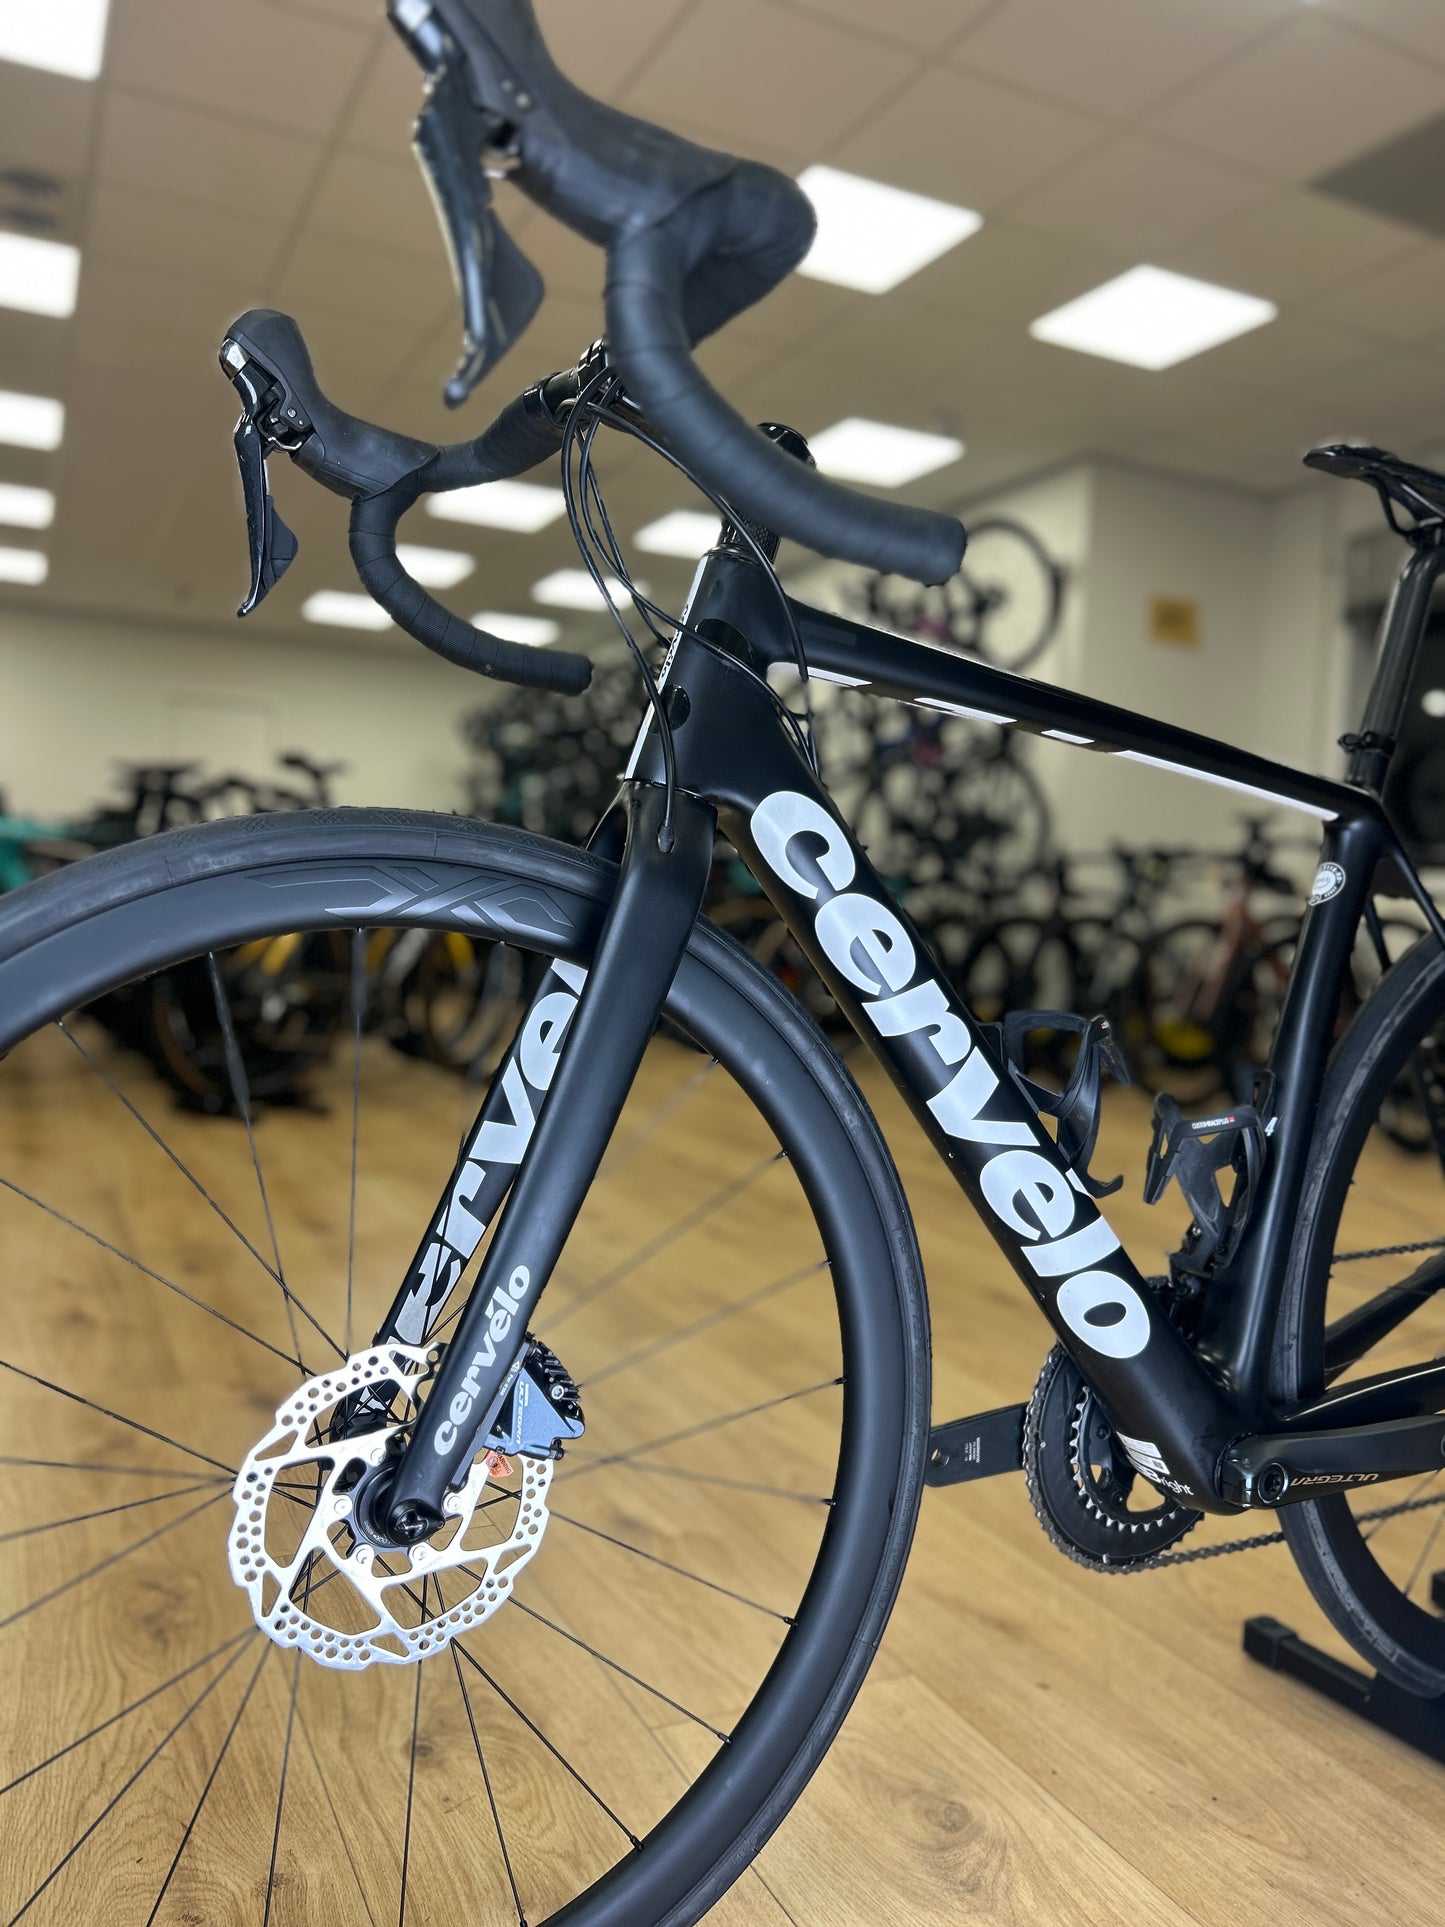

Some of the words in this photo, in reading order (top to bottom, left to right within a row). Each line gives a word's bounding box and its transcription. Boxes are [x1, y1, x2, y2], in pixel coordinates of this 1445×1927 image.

[751, 791, 1151, 1358] cervélo
[434, 1265, 531, 1456] cervélo
[515, 1380, 526, 1445] ULTEGRA
[1290, 1473, 1379, 1487] ULTEGRA
